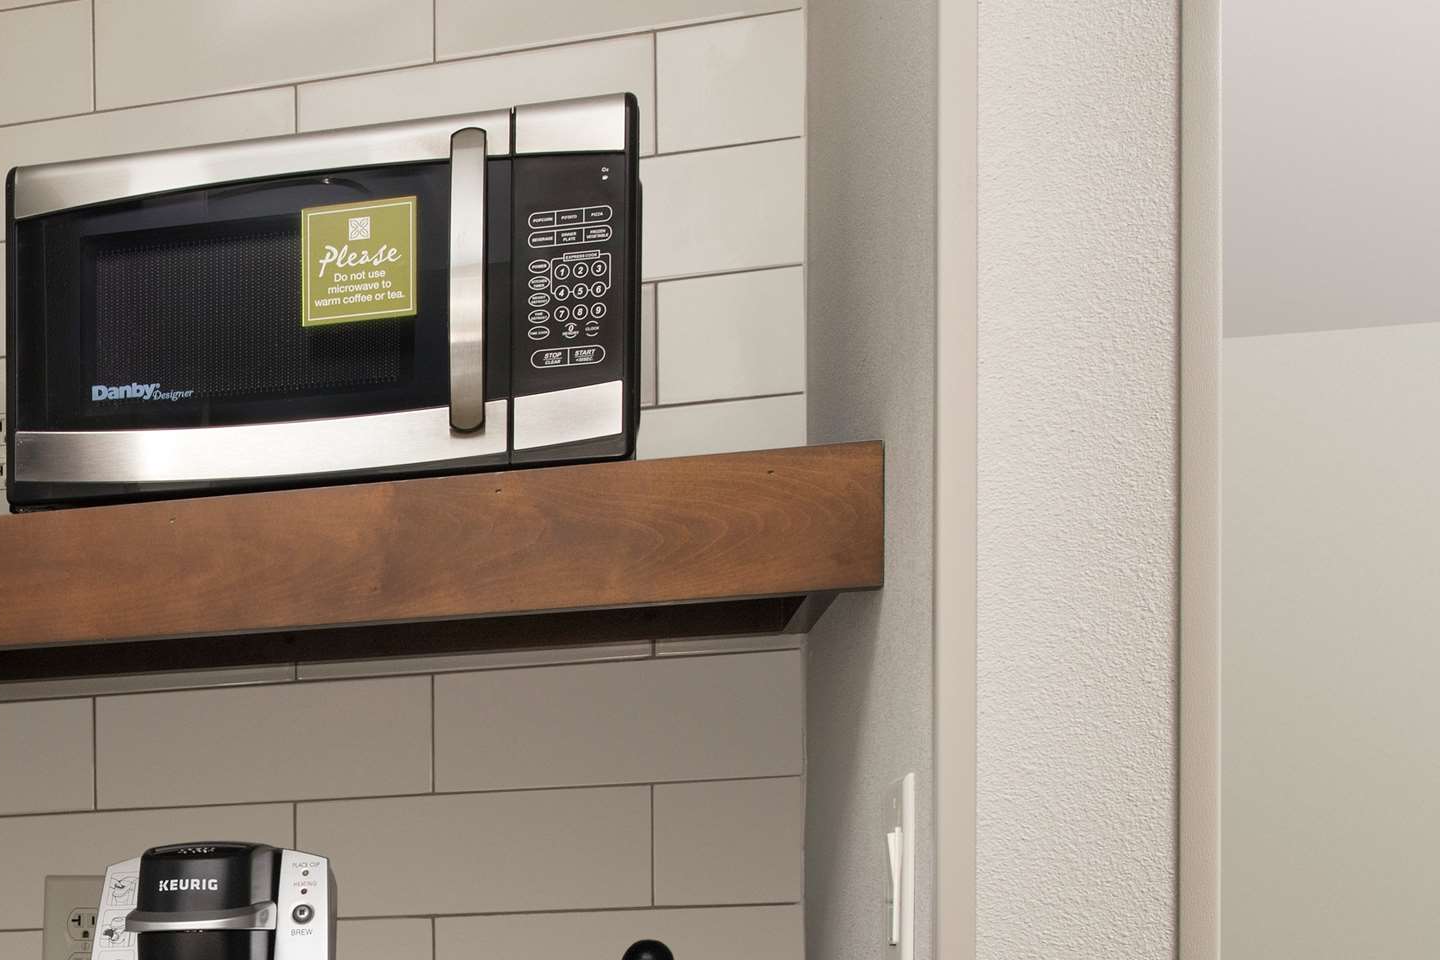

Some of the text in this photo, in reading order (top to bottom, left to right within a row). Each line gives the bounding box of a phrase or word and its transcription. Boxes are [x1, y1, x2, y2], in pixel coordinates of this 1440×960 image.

[319, 244, 402, 278] Please
[333, 270, 386, 282] Do not use
[560, 264, 602, 277] 1 2 3
[327, 280, 392, 295] microwave to
[558, 285, 602, 297] 4 5 6
[314, 289, 405, 307] warm coffee or tea.
[559, 306, 602, 319] 7 8 9
[574, 349, 596, 358] START
[152, 390, 194, 401] Designer
[159, 878, 219, 892] KEURIG
[290, 928, 313, 936] BREW
